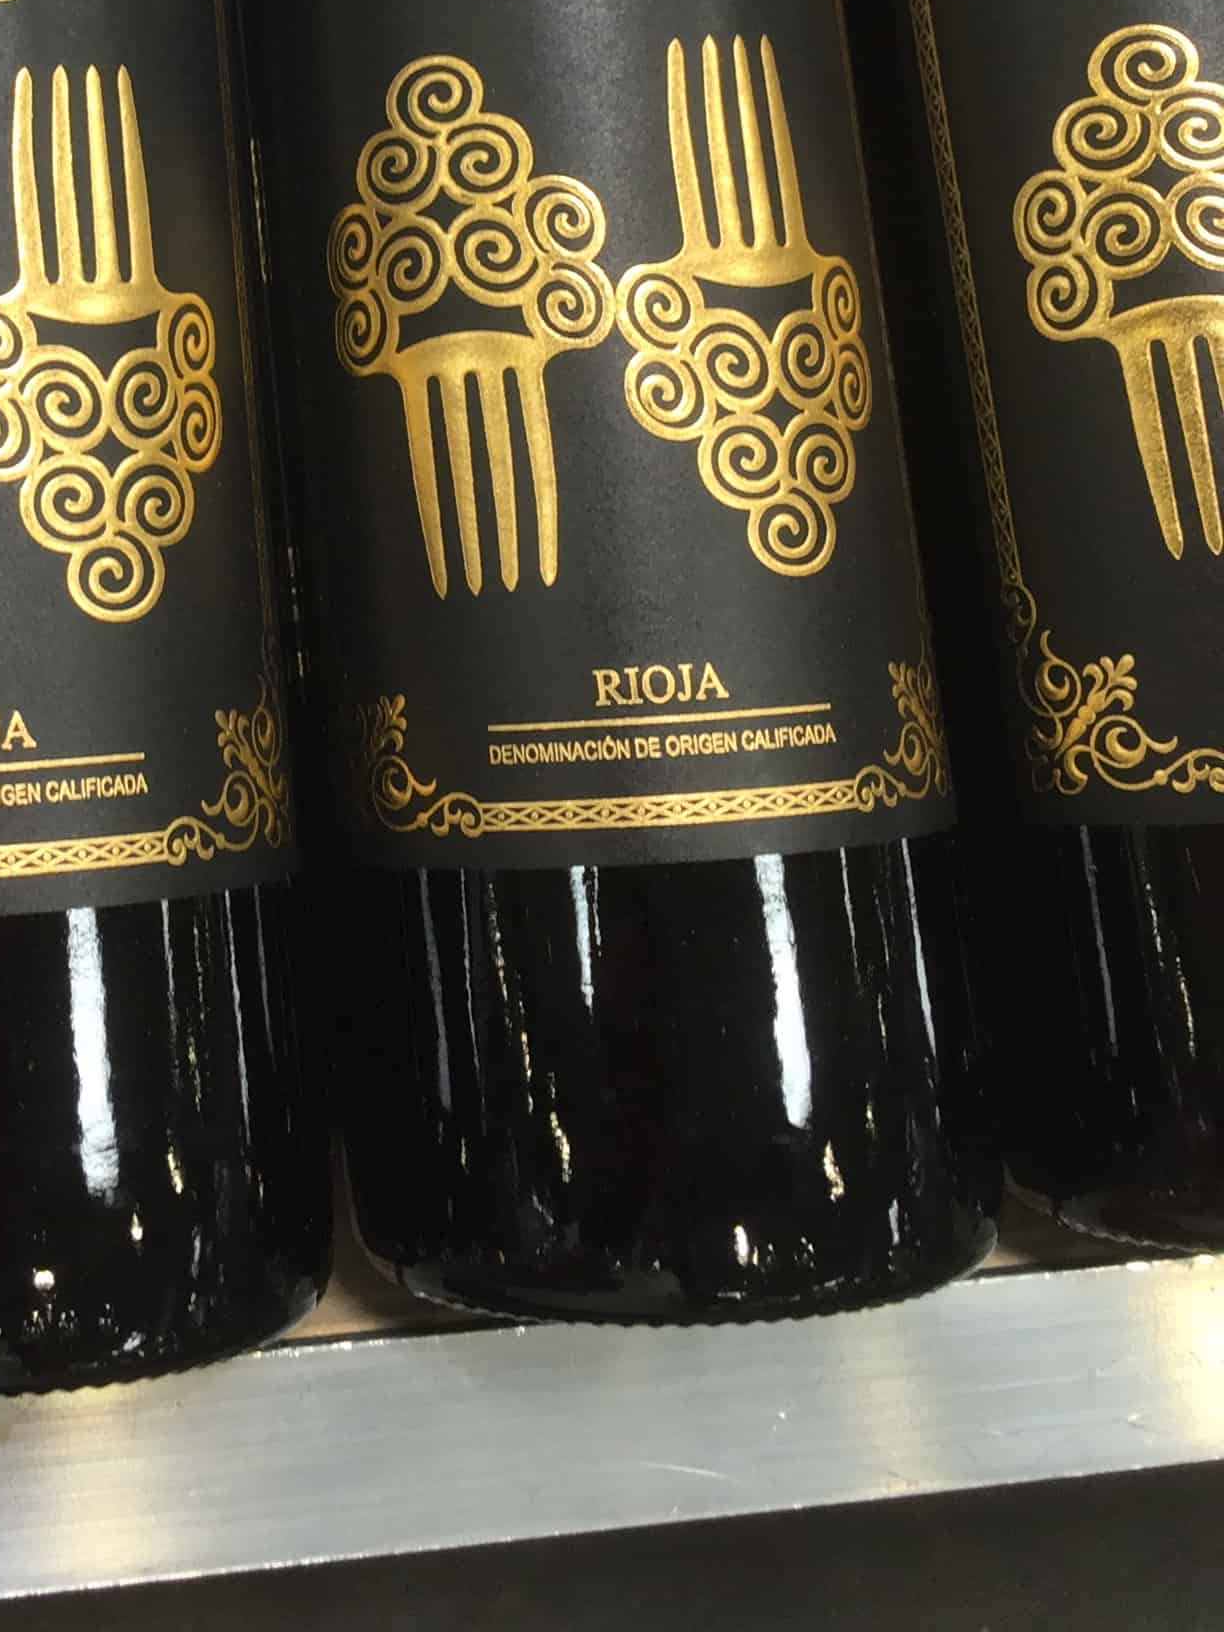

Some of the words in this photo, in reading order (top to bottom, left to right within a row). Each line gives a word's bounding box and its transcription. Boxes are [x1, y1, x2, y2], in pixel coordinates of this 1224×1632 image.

[592, 661, 729, 707] RIOJA
[488, 737, 631, 766] DENOMINACIÓN
[635, 738, 662, 760] DE
[665, 731, 739, 758] ORIGEN
[743, 722, 837, 752] CALIFICADA
[45, 771, 149, 804] CALIFICADA
